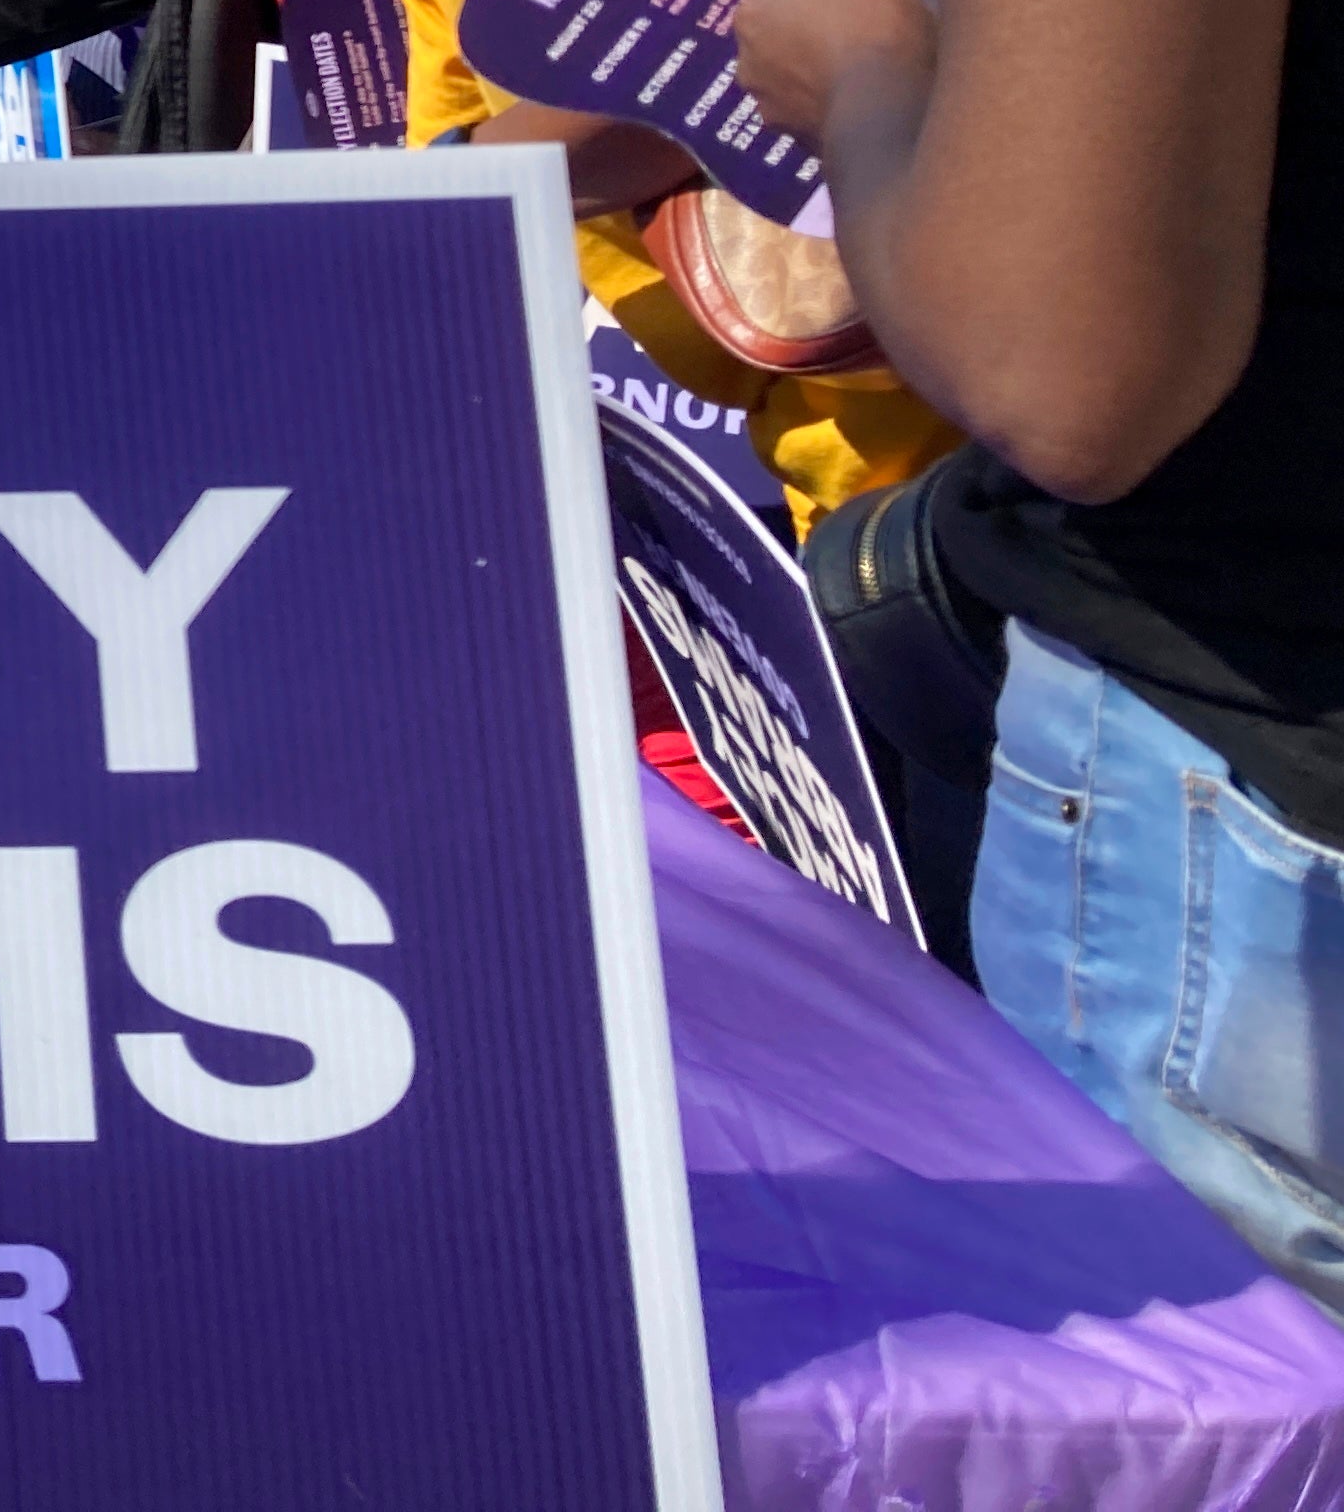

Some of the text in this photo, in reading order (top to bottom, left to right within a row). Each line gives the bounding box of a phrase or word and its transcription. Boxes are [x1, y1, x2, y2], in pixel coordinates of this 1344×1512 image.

[311, 32, 338, 75] DATES
[322, 77, 354, 140] ELECTION
[716, 94, 756, 141] OCTOBE
